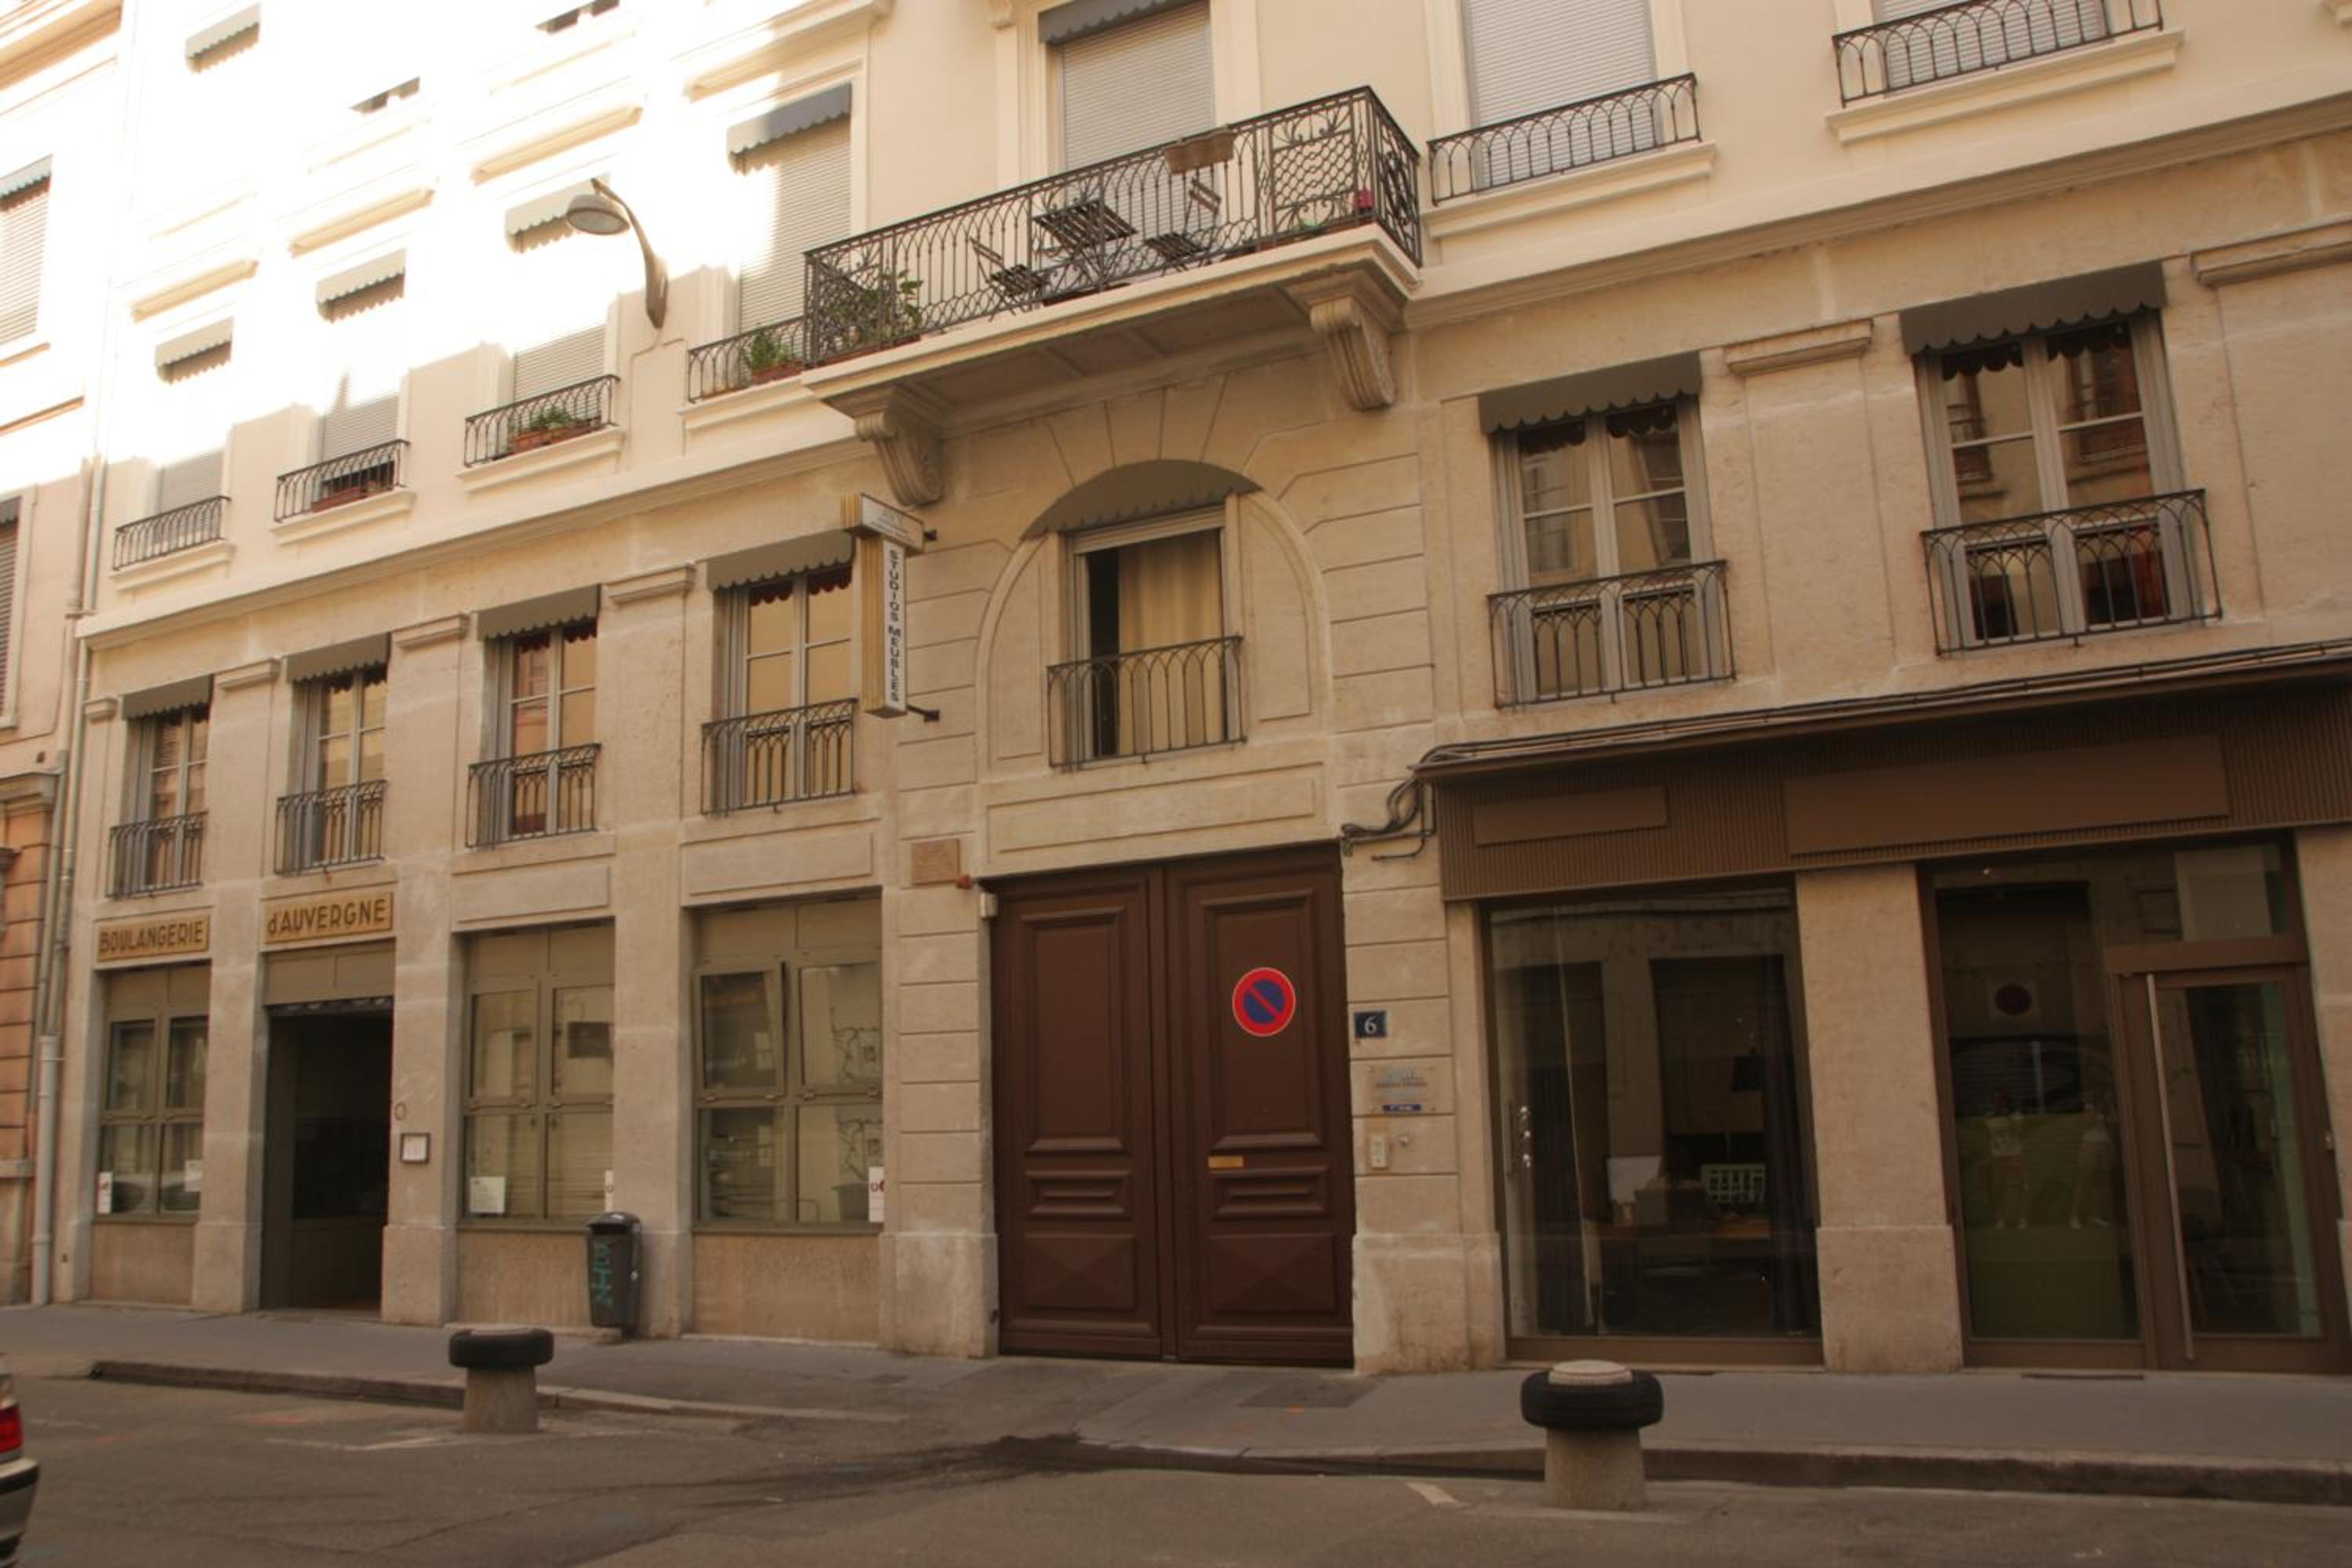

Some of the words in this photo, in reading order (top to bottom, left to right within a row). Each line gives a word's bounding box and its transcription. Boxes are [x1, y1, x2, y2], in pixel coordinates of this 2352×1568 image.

[888, 549, 900, 622] STUDIOS
[99, 920, 204, 953] BOULANGERIE
[1364, 1017, 1377, 1035] 6
